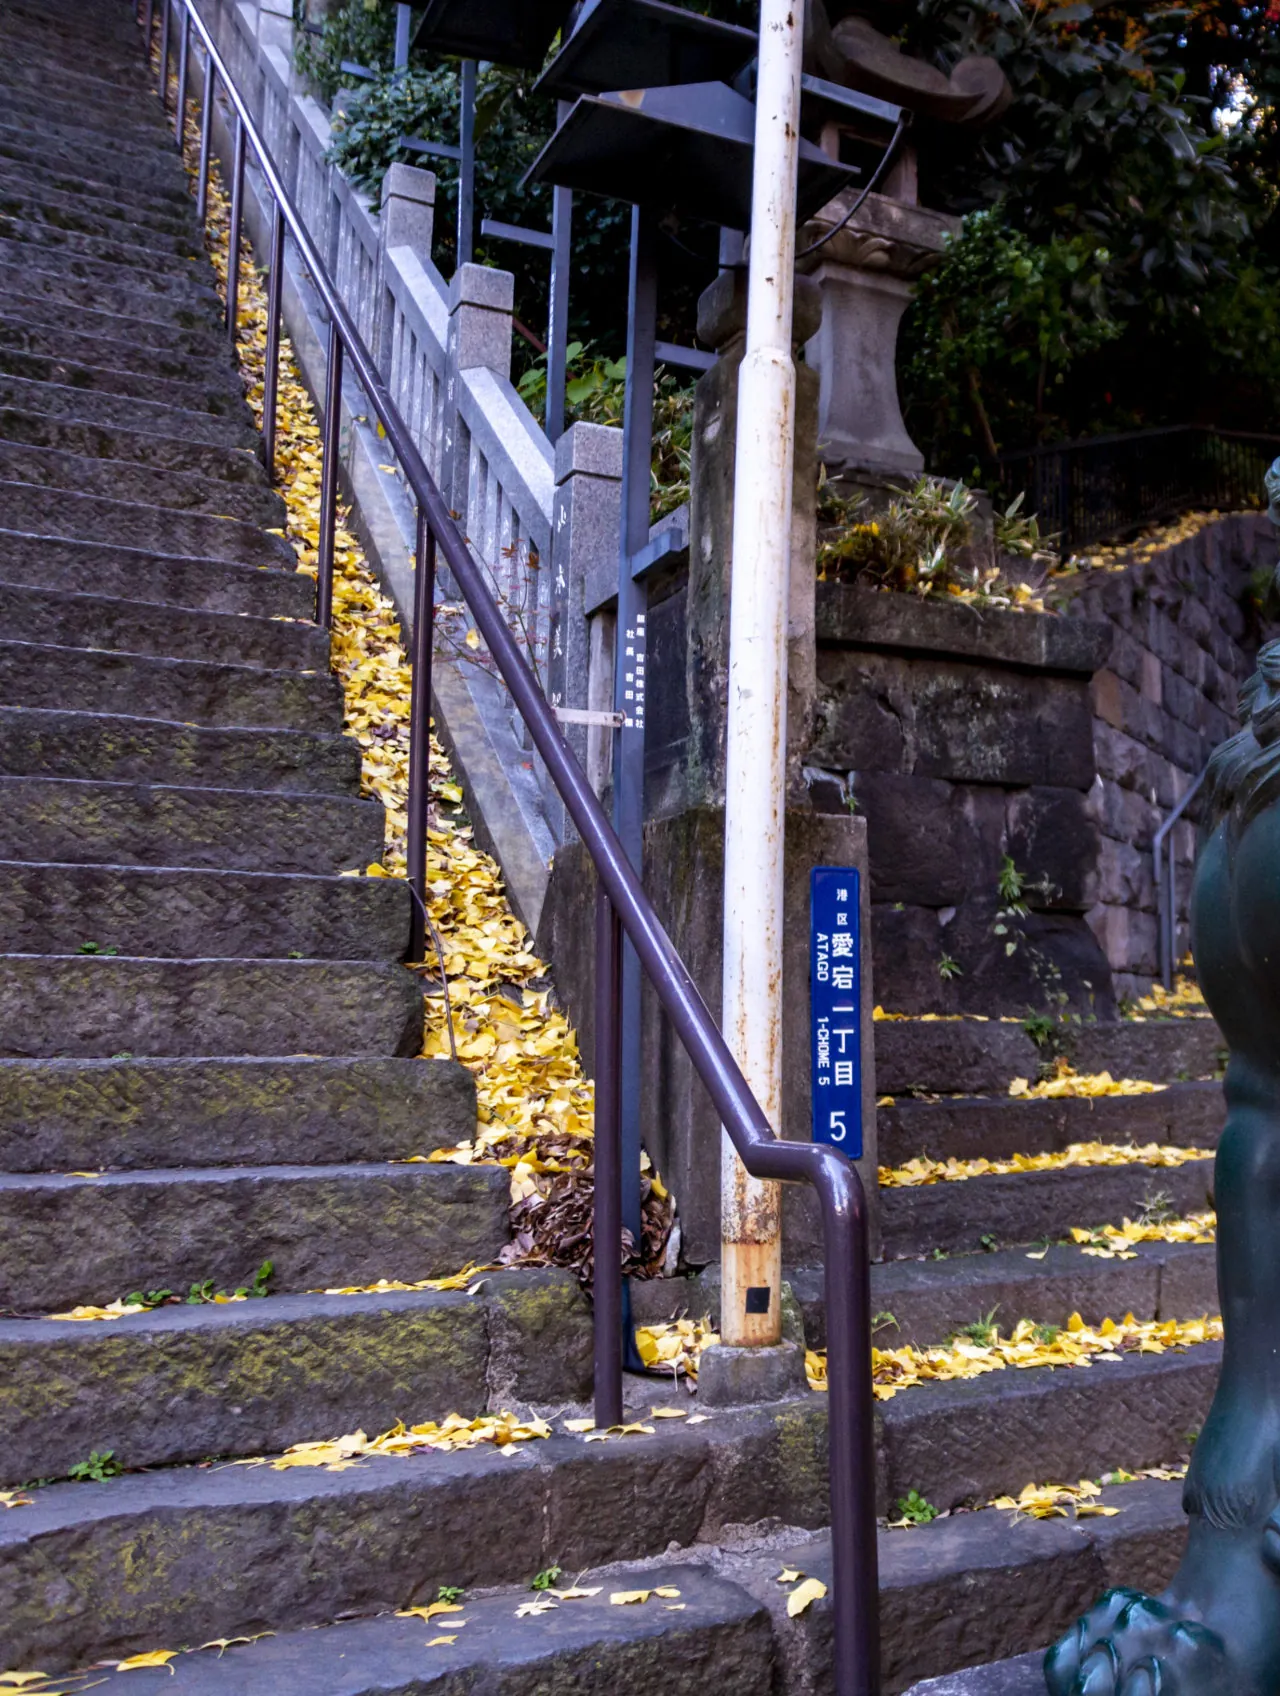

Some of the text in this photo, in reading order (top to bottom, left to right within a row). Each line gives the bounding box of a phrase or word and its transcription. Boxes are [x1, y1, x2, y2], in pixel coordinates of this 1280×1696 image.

[816, 932, 830, 1086] ATAGO 1-CHOME 5
[832, 888, 854, 1086] 港区 愛宕一丁目
[830, 1111, 847, 1141] 5
